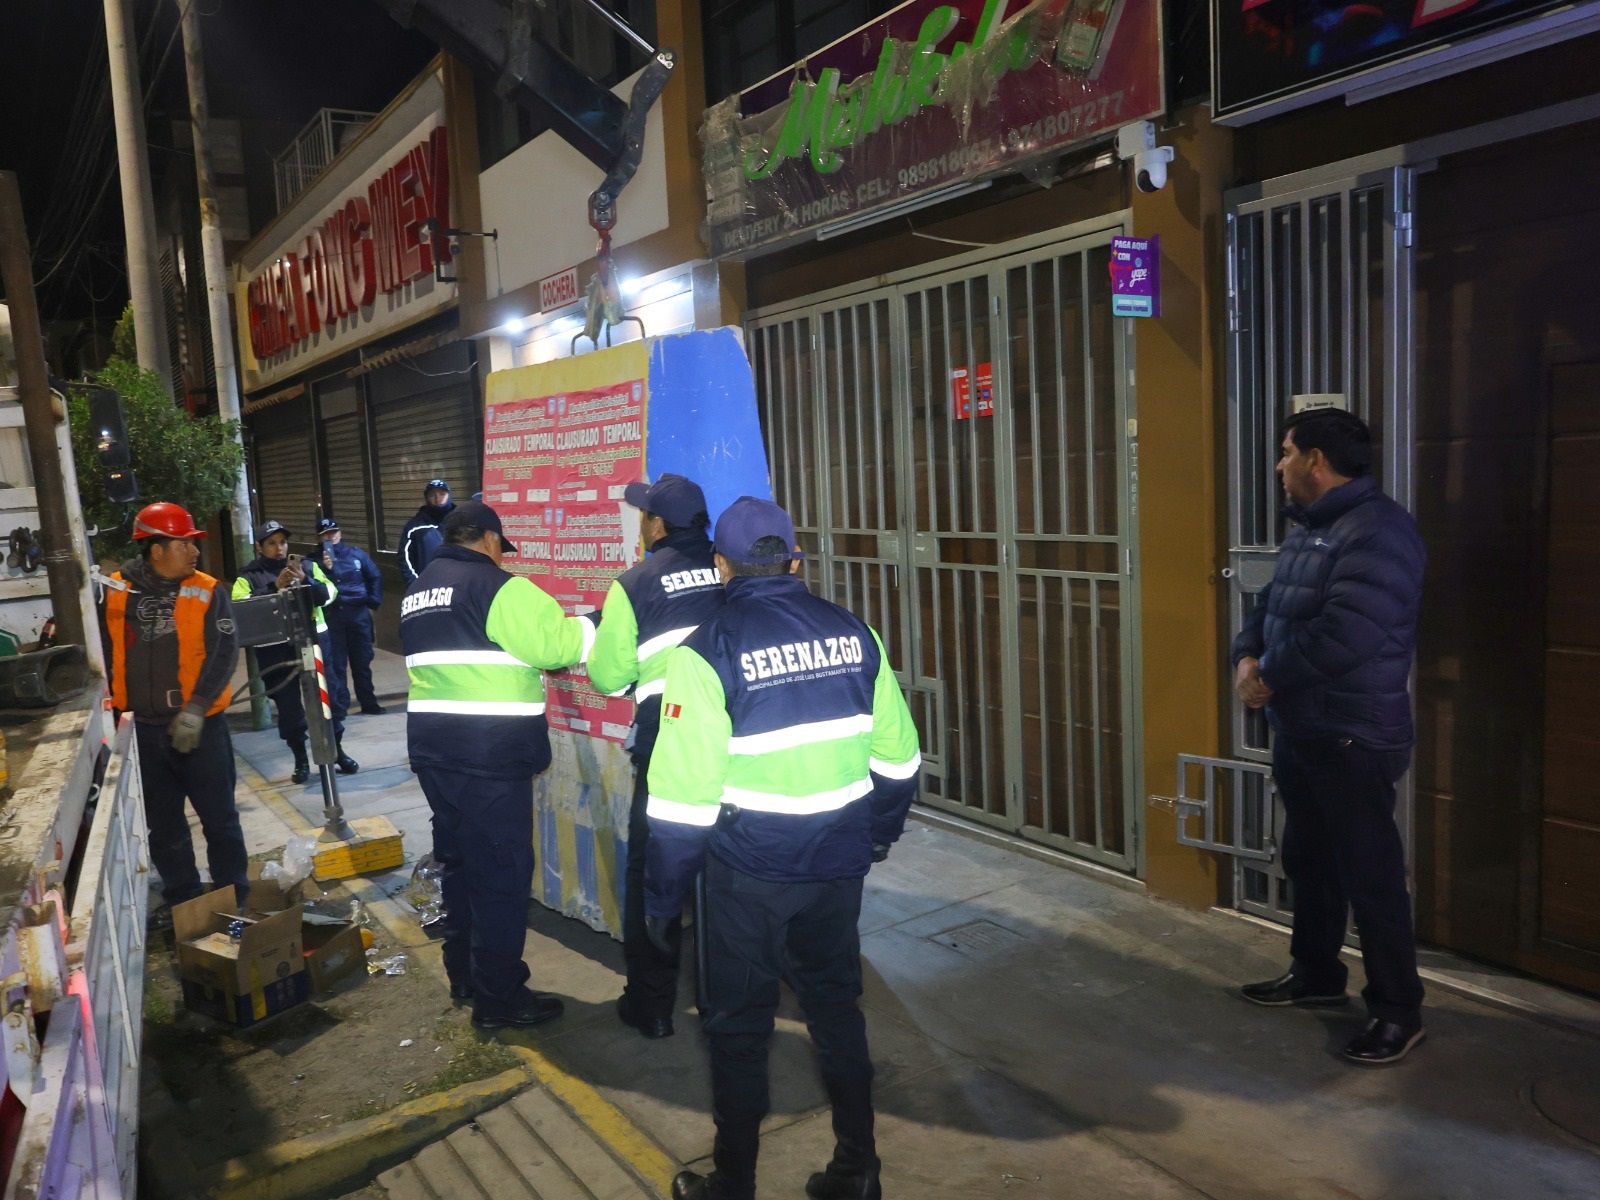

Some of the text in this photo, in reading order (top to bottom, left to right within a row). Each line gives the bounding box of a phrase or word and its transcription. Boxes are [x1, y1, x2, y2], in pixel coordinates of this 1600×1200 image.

[724, 214, 780, 249] DELIVERY
[802, 190, 849, 224] HORAS
[247, 126, 452, 358] CHIFA FONG MEY
[1114, 240, 1148, 251] PAGA AQUÍ
[1117, 252, 1130, 261] CON
[1129, 268, 1148, 287] yape
[543, 272, 576, 307] COCHERA
[568, 393, 629, 414] Municipalidad Distrital
[582, 408, 614, 423] Bustamante
[620, 405, 640, 417] Rivero
[486, 432, 554, 455] CLAUSURADO TEMPORAL
[556, 420, 642, 451] CLAUSURADO TEMPORAL
[556, 455, 566, 468] Ley
[596, 445, 640, 462] Municipalidades
[578, 463, 591, 476] LEY
[566, 514, 602, 526] Municipalidad
[556, 527, 568, 538] José
[580, 526, 612, 538] Bustamante
[520, 541, 551, 560] TEMPORAL
[554, 542, 597, 561] CLAUSURADO
[577, 579, 590, 591] LEY
[741, 636, 862, 682] SERENAZGO
[747, 677, 786, 691] MUNICIPALIDAD
[815, 668, 847, 678] BUSTAMANTE
[572, 693, 585, 706] LEY
